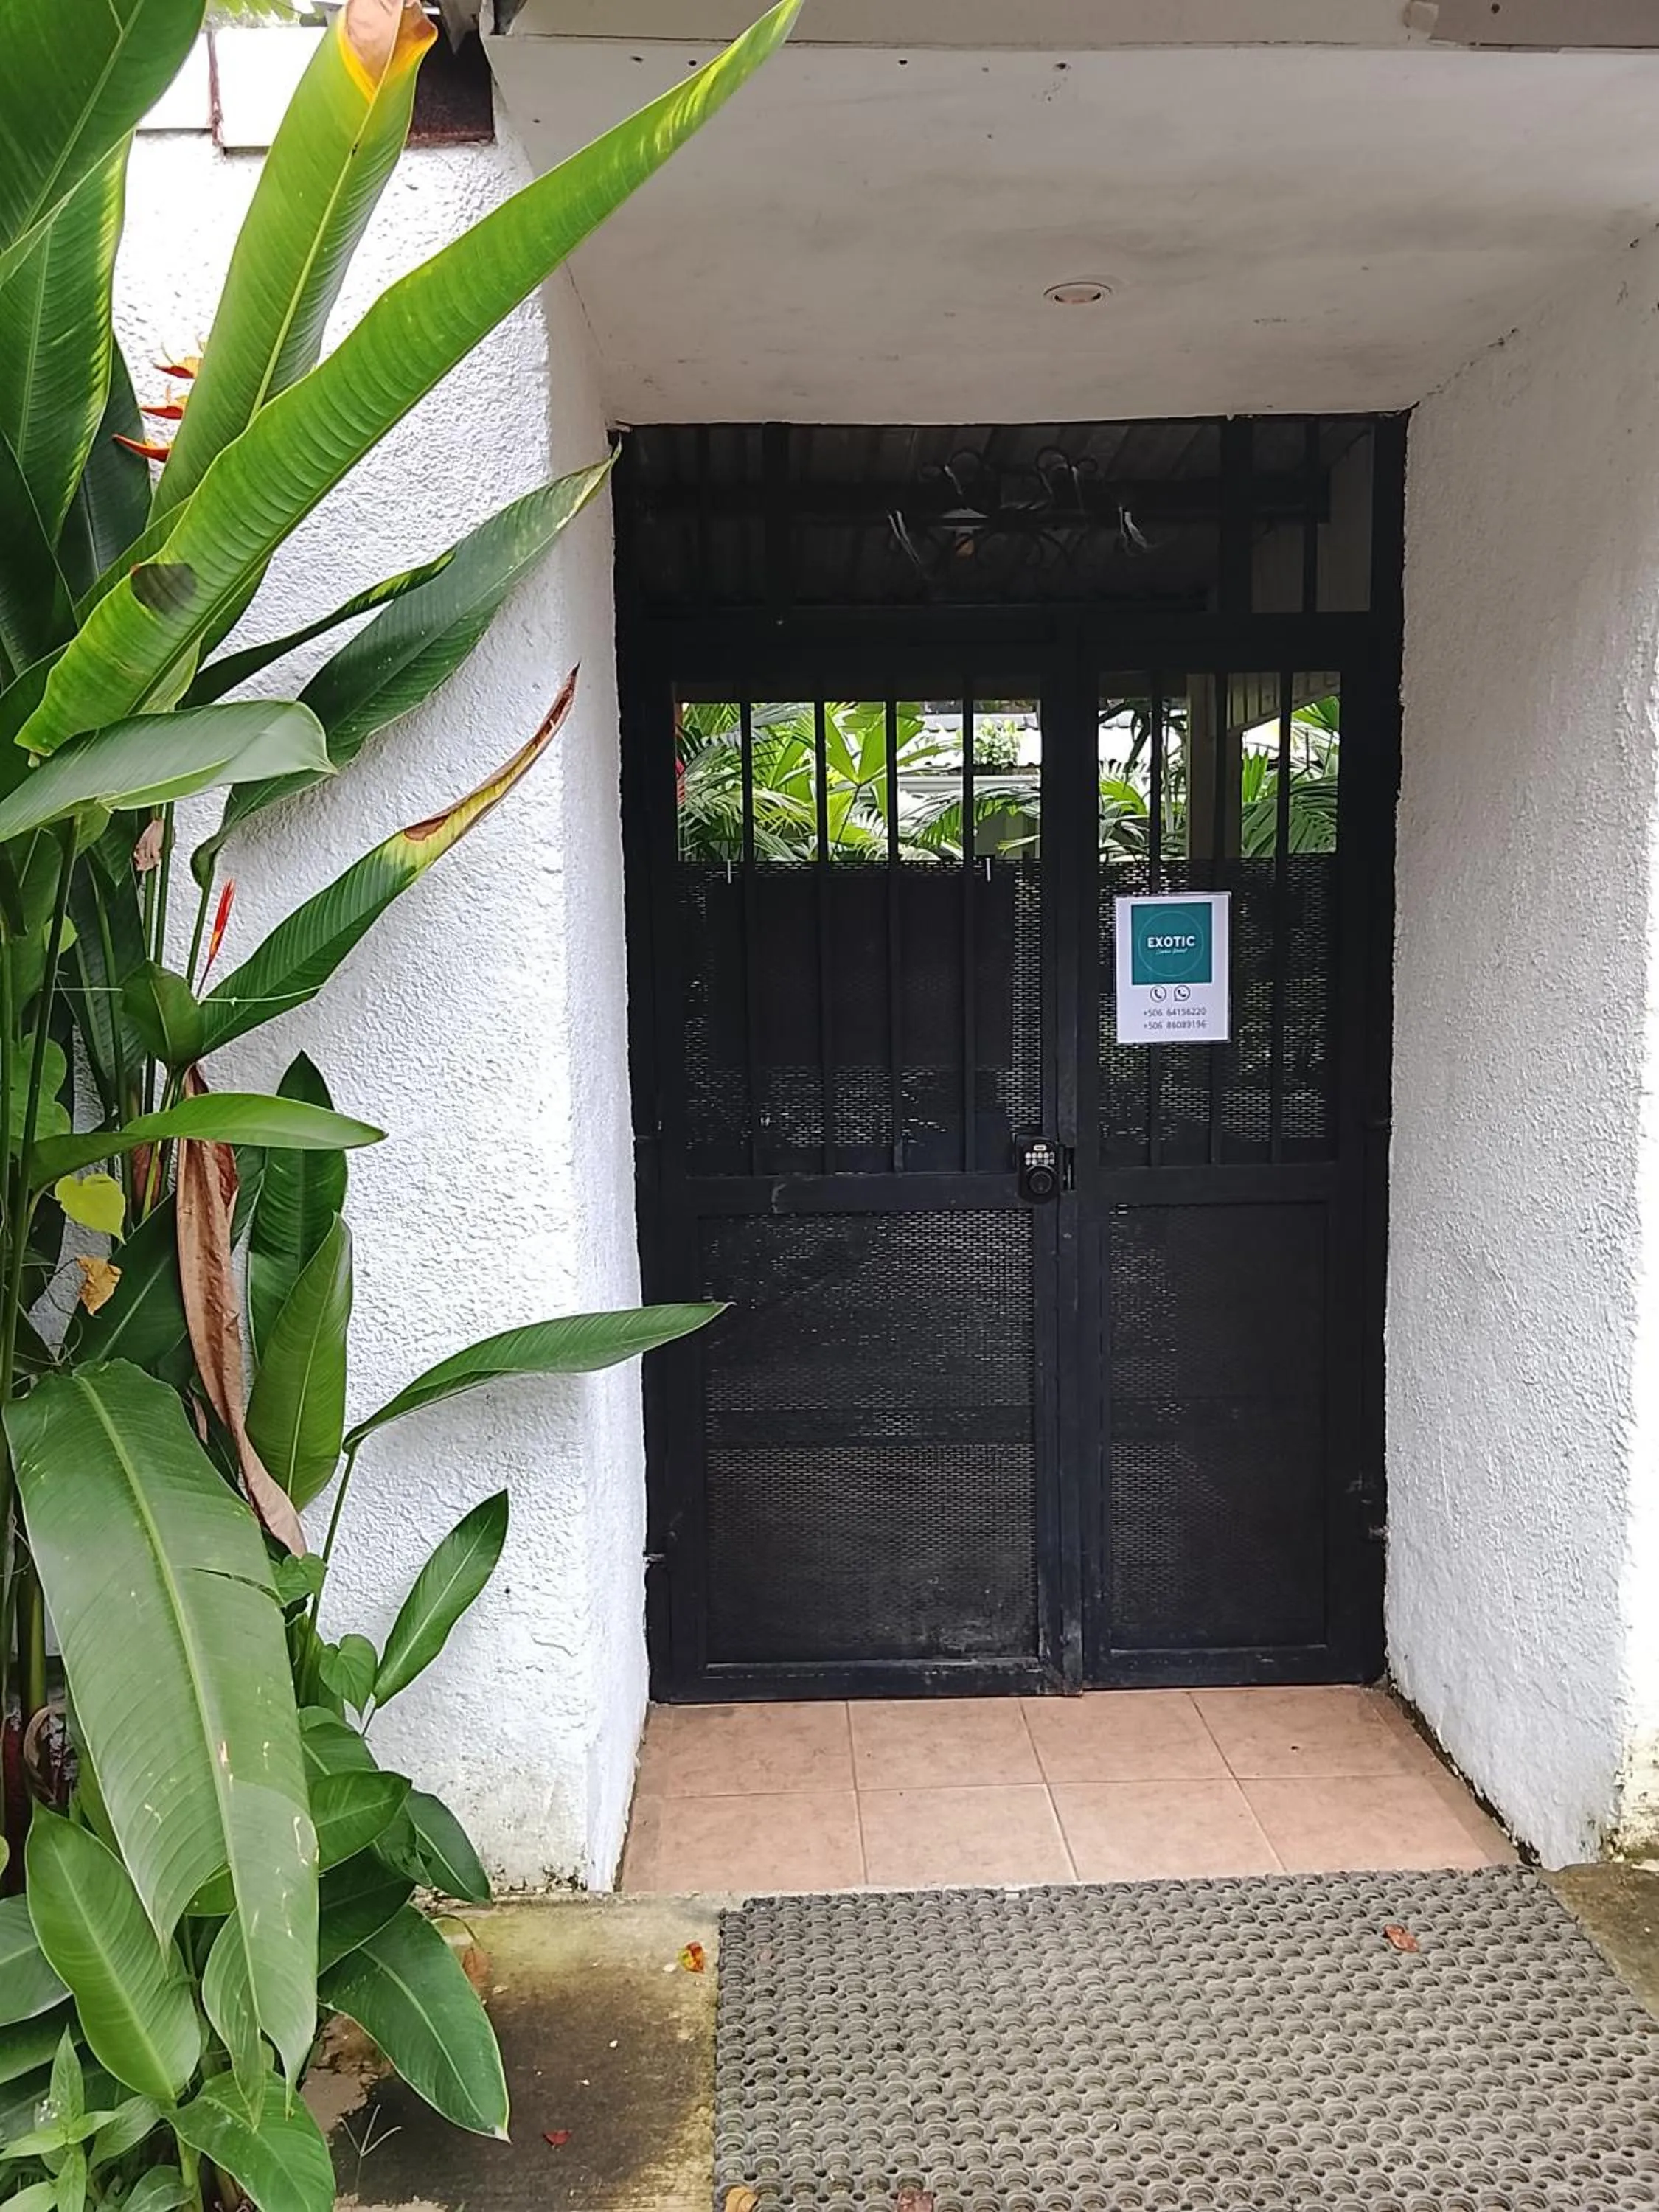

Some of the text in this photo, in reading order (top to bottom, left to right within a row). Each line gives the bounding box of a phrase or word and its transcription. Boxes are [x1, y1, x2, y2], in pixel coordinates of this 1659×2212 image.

[1147, 936, 1195, 948] EXOTIC
[1144, 1008, 1162, 1016] +506
[1144, 1021, 1162, 1029] +506
